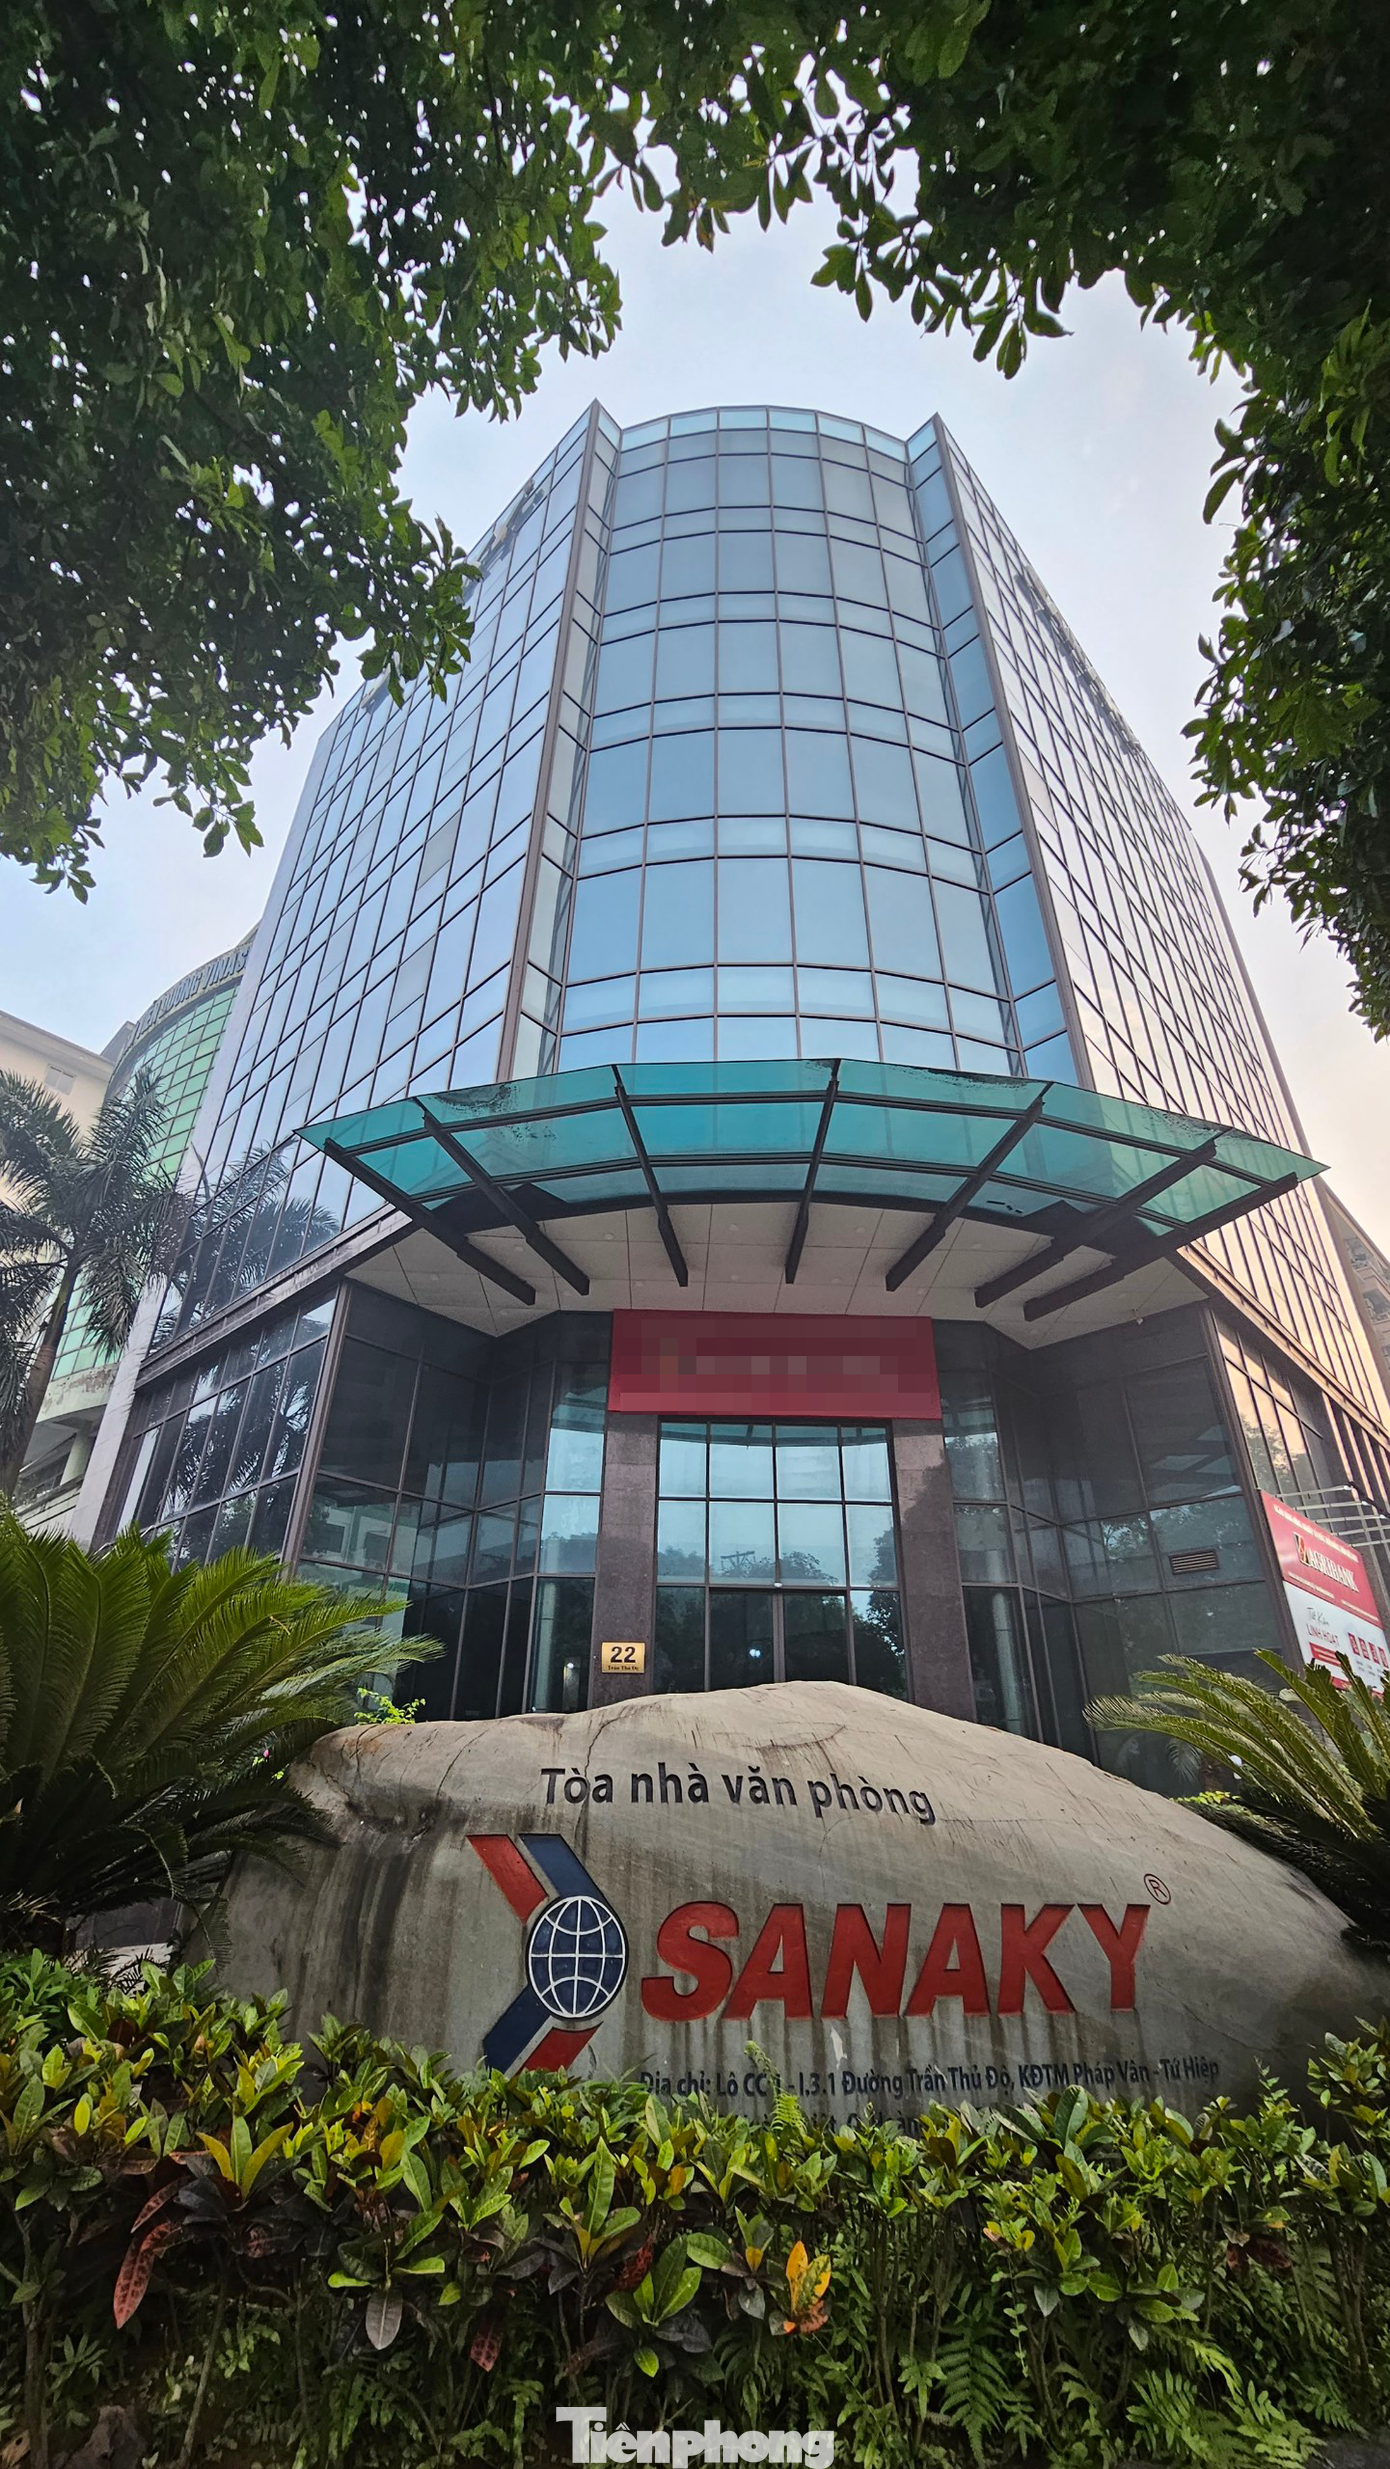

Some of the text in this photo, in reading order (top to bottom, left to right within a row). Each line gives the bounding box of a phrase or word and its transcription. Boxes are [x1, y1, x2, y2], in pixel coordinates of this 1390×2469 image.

[1307, 1547, 1359, 1592] AGRIBANK
[610, 1646, 636, 1663] 22
[541, 1762, 936, 1825] Tòa nhà văn phòng
[641, 1901, 1151, 2021] SANAKY
[716, 2071, 739, 2097] Lô
[842, 2069, 904, 2100] Đường
[905, 2064, 946, 2092] Trần
[947, 2065, 982, 2091] Thủ
[985, 2065, 1015, 2095] Độ,
[1018, 2063, 1070, 2088] KĐTM
[1073, 2061, 1115, 2090] Pháp
[1117, 2060, 1150, 2083] Vân
[1159, 2057, 1181, 2081] Tứ
[1182, 2056, 1219, 2084] Hiệp
